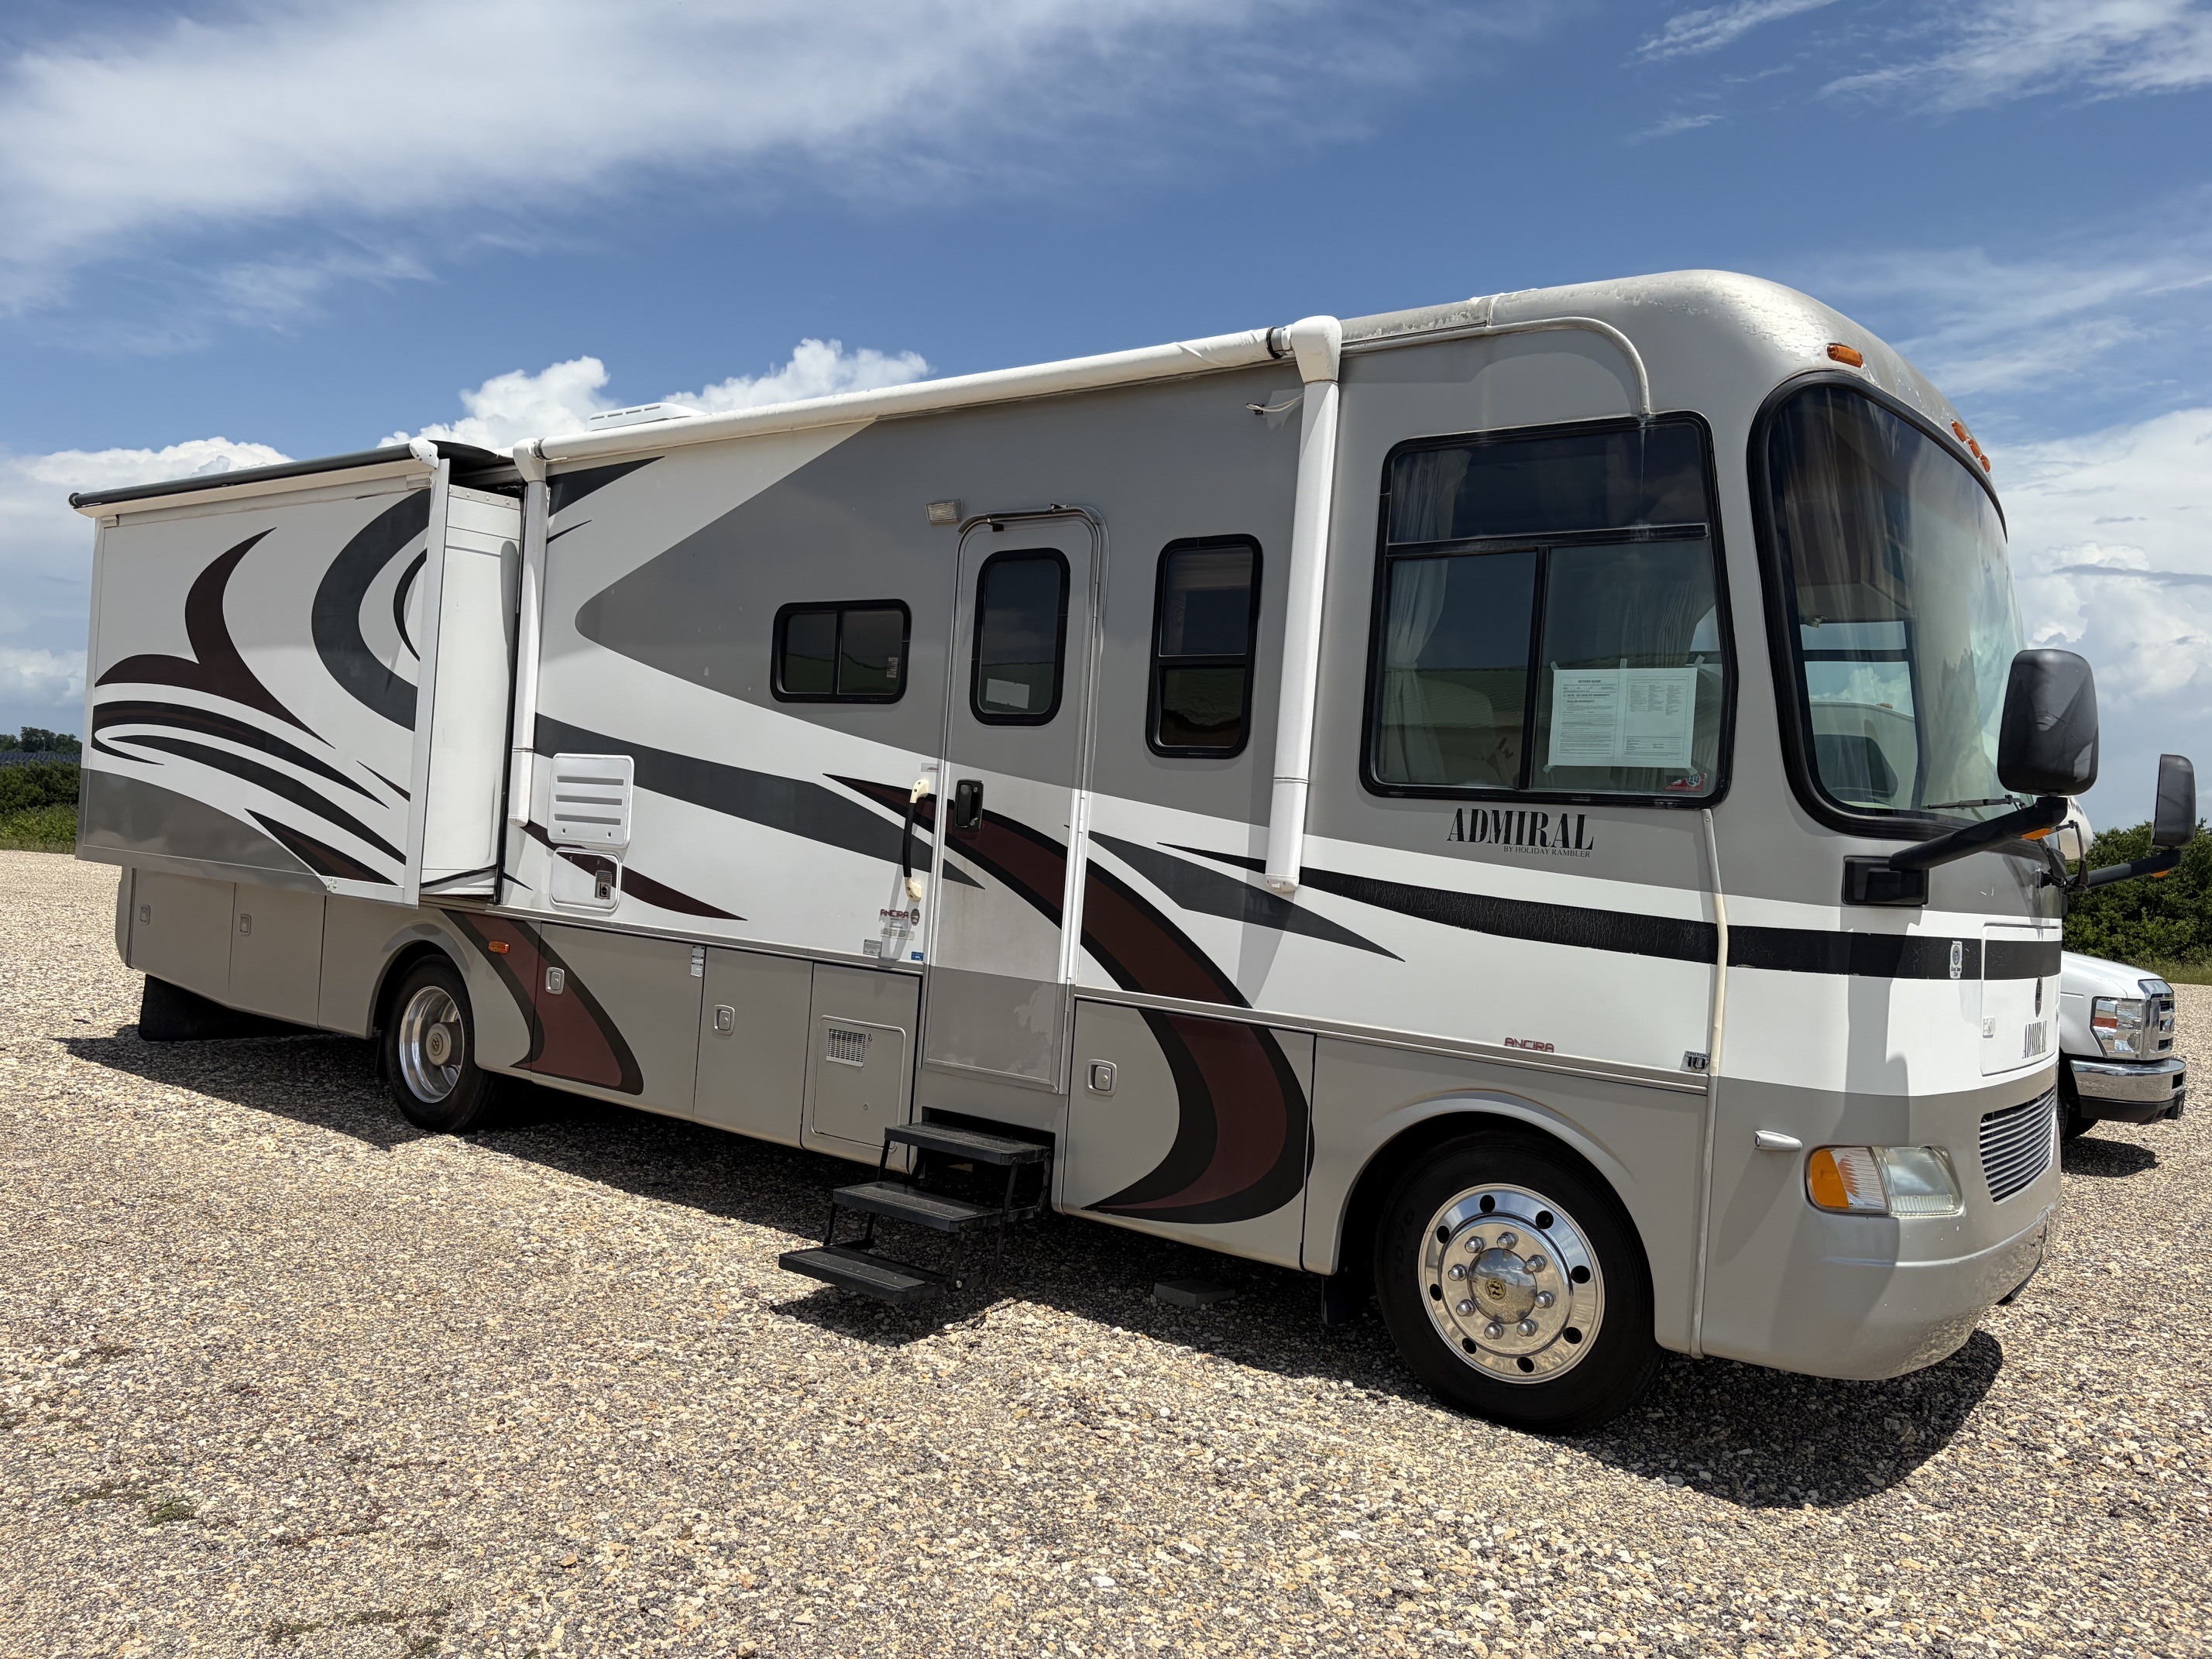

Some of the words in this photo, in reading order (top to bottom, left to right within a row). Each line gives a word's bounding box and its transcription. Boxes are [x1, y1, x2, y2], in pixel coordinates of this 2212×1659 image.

[1446, 808, 1595, 850] ADMIRAL
[1515, 847, 1550, 855] HOLIDAY
[1551, 849, 1591, 858] RAMBLER
[880, 908, 909, 919] ANCIRA
[1503, 1037, 1554, 1053] ANCIRA
[2021, 1020, 2047, 1059] ADMIRAL
